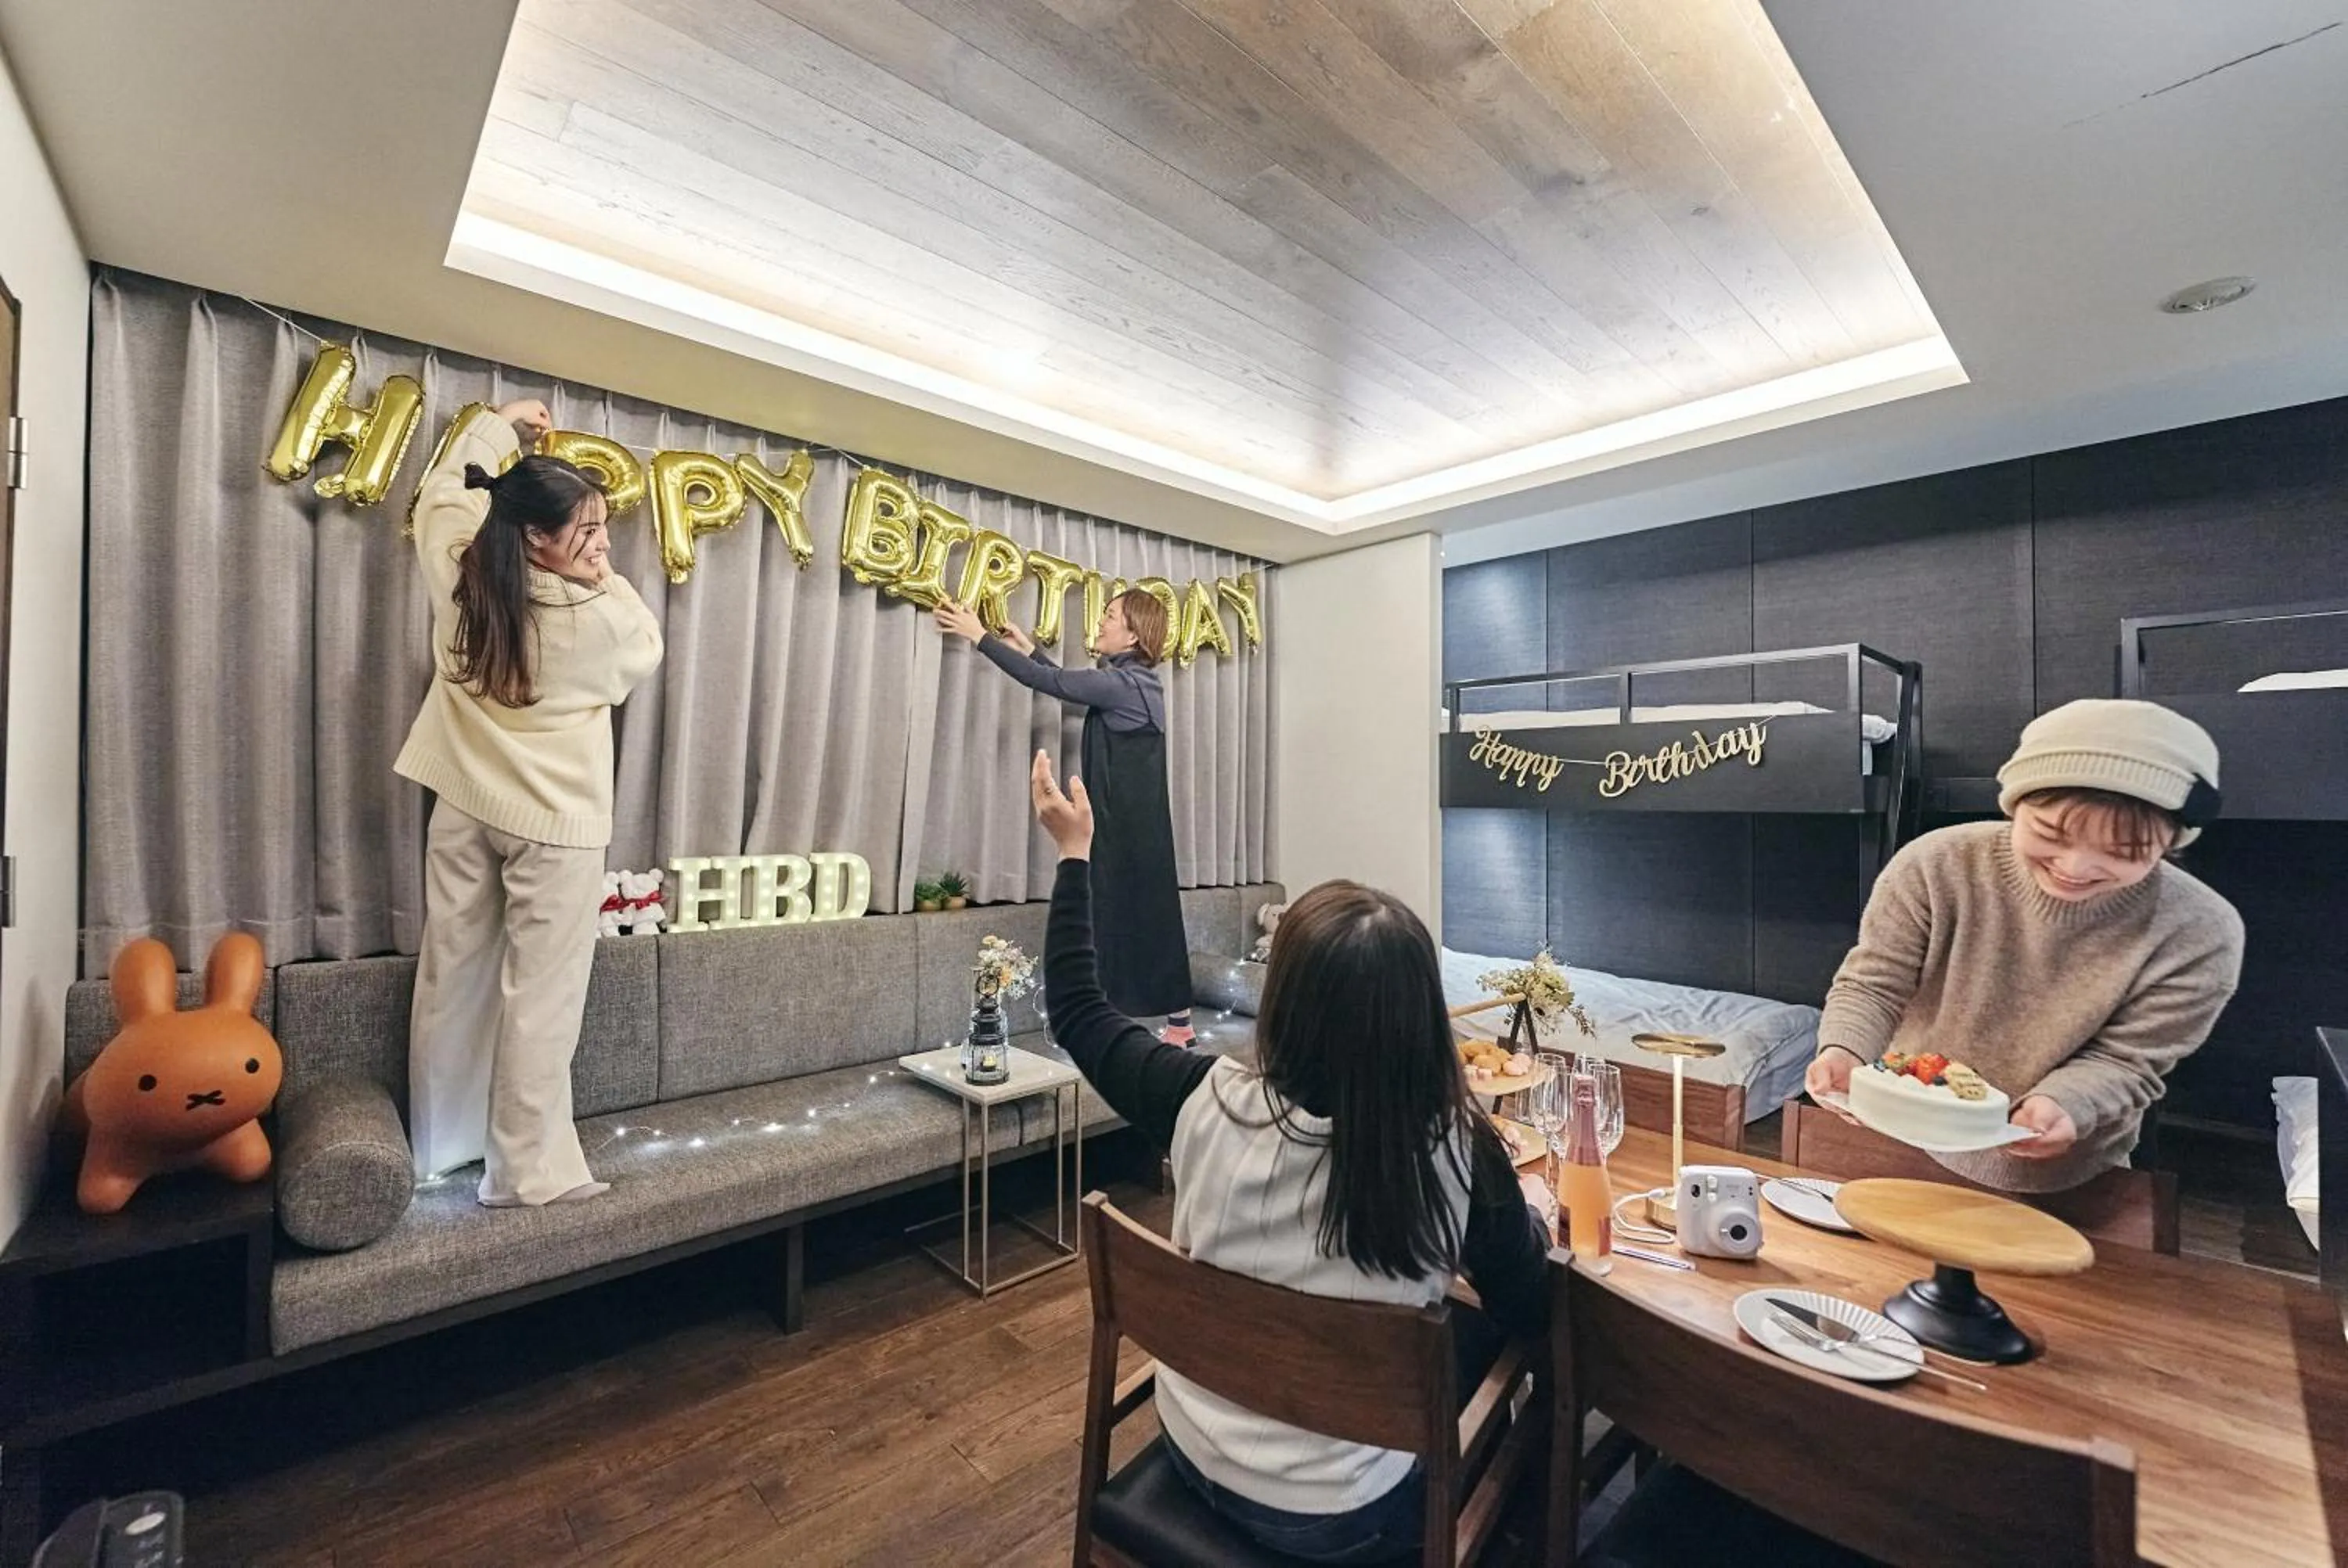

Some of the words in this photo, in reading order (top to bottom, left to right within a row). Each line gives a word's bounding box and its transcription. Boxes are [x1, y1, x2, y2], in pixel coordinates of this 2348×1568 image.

[266, 341, 815, 584] HPPY
[1469, 725, 1565, 792] Happy
[1599, 722, 1766, 797] Birthday
[667, 851, 871, 933] HBD
